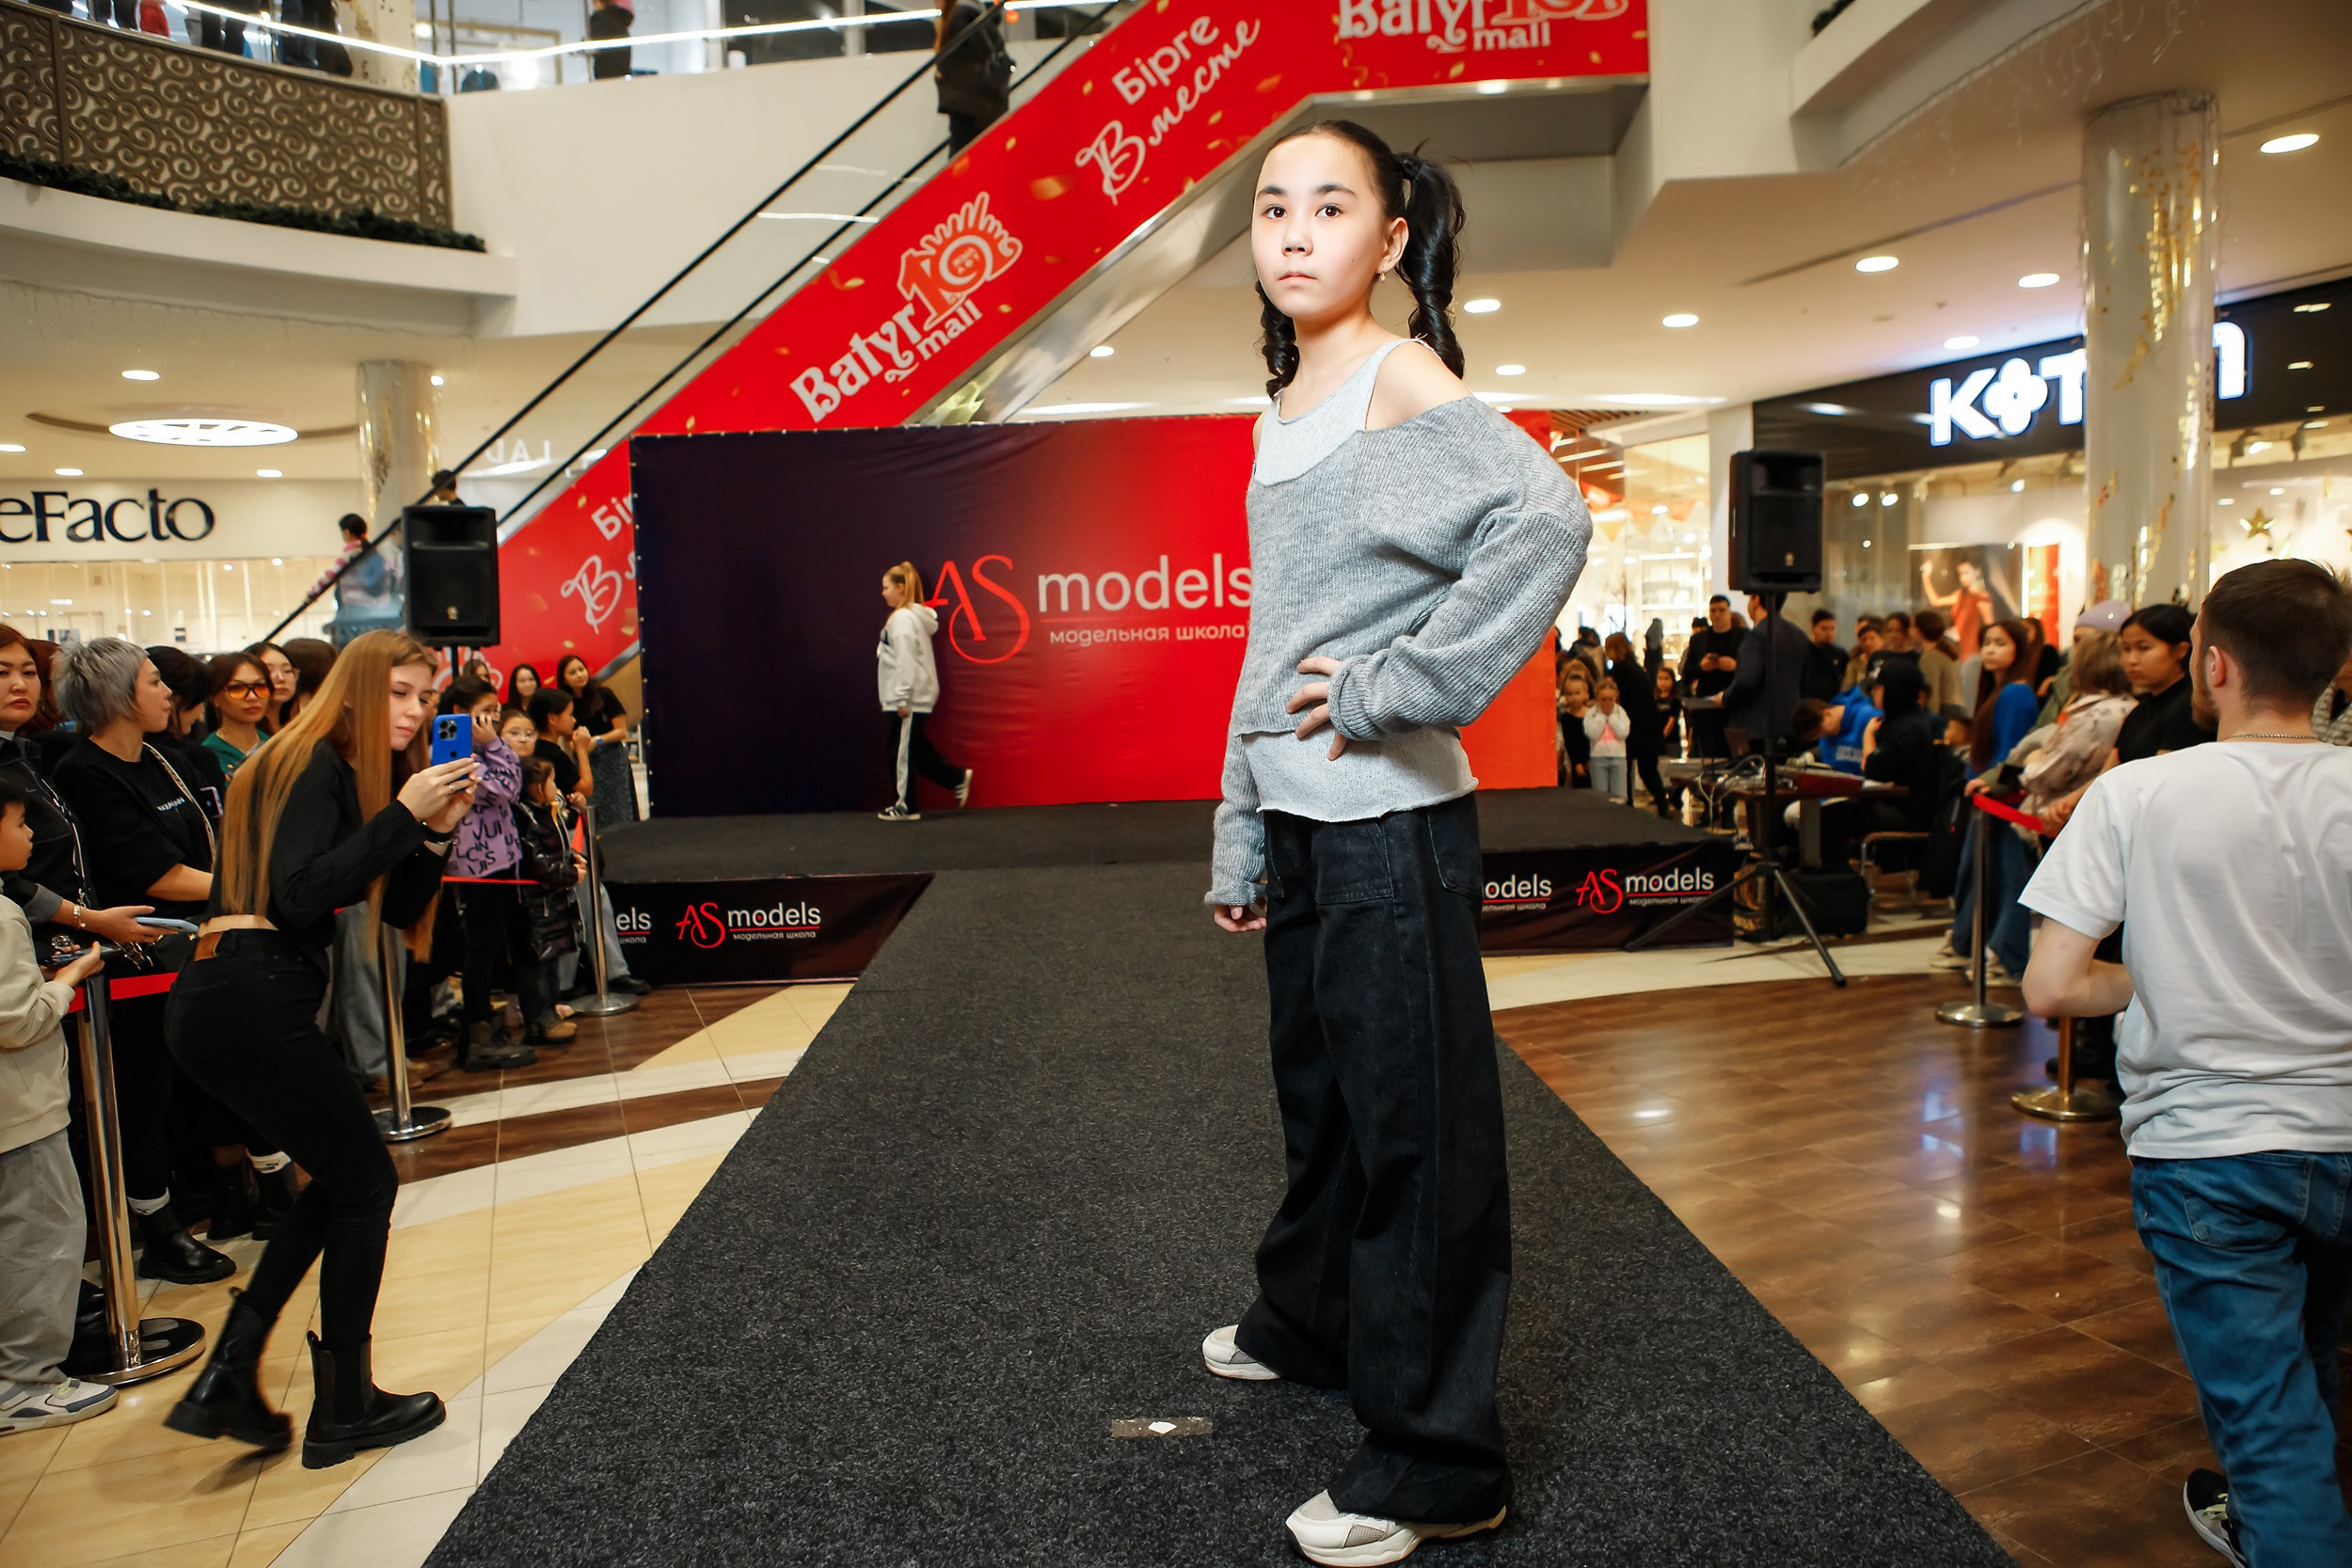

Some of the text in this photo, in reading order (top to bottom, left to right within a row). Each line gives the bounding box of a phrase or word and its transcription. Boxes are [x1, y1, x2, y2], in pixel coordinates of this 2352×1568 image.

[1112, 15, 1219, 105] Бірге
[1472, 21, 1550, 51] mall
[1074, 18, 1261, 206] Вместе
[915, 299, 983, 361] mall
[789, 302, 921, 423] Batyr
[924, 553, 1252, 664] AS models
[1050, 624, 1245, 646] модельная школа
[1482, 874, 1552, 899] odels
[1576, 866, 1714, 914] AS models
[675, 901, 821, 949] AS models
